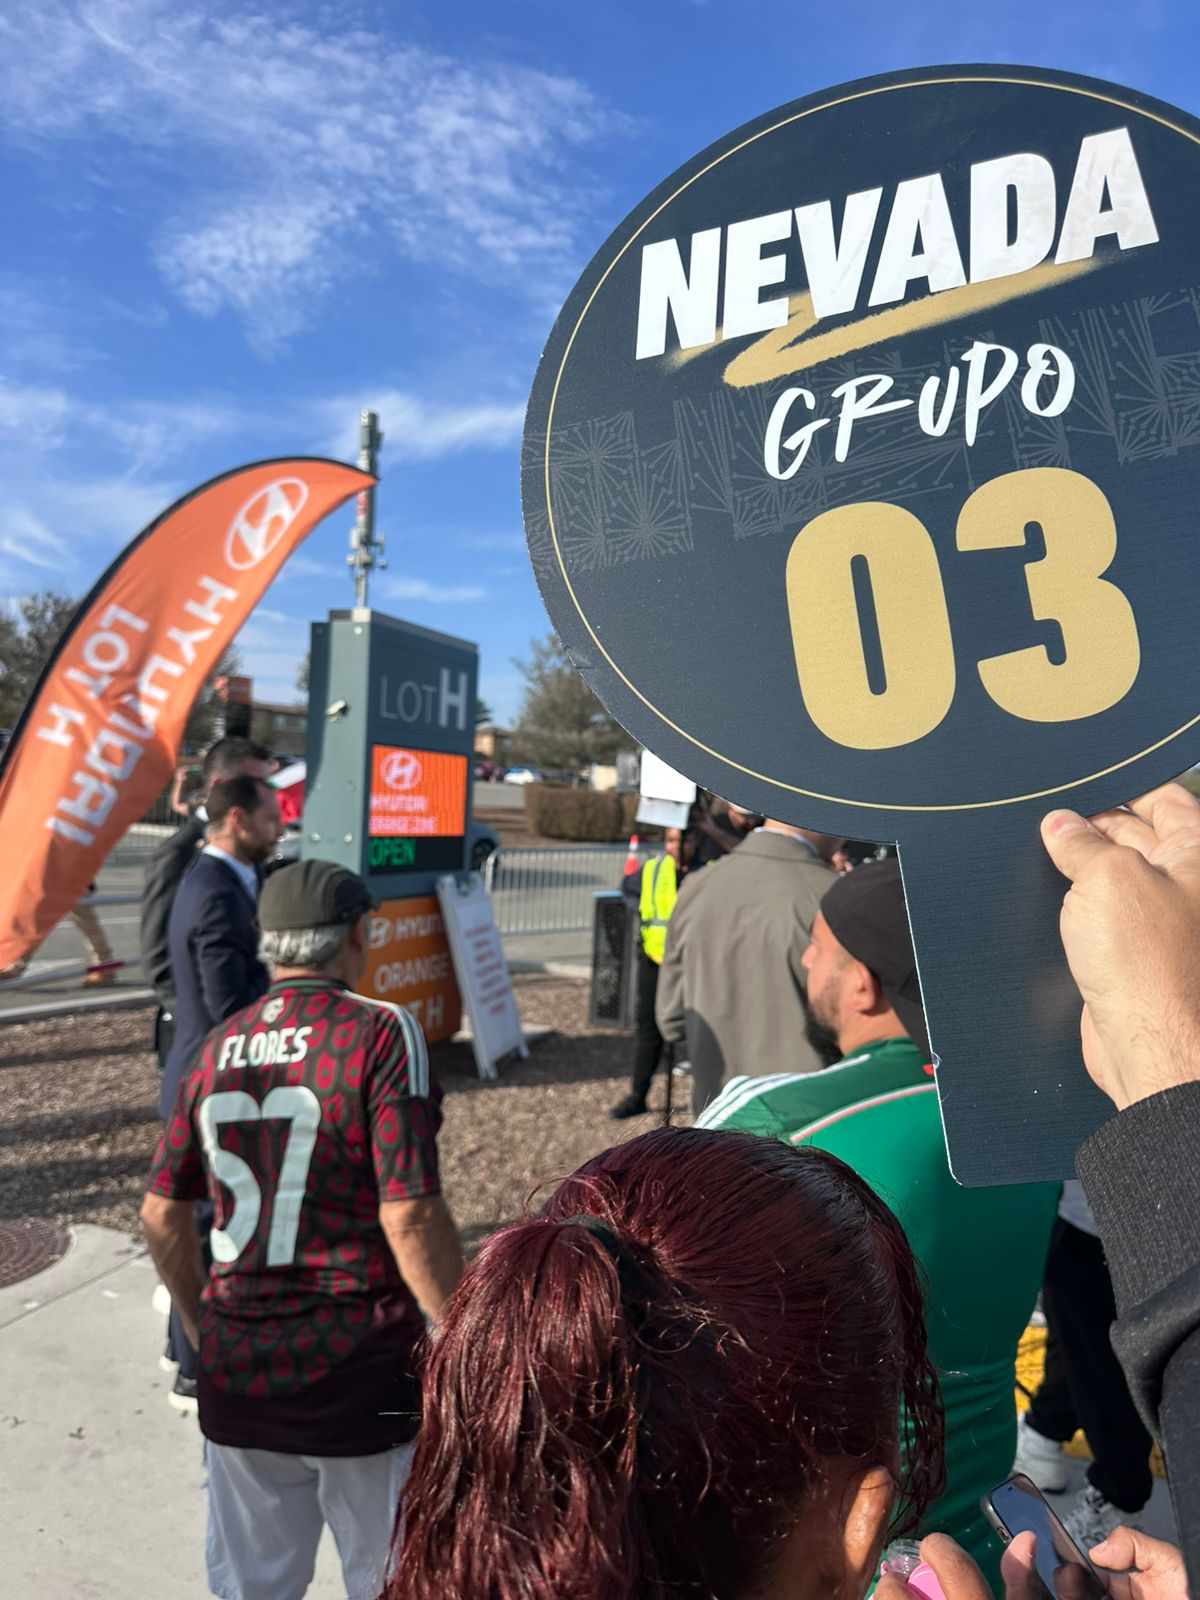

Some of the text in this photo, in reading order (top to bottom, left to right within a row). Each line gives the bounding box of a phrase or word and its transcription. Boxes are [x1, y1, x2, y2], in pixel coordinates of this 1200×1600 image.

[636, 127, 1160, 361] NEVADA
[763, 341, 1076, 481] GRUPO
[36, 602, 151, 748] LOT H
[785, 467, 1141, 750] 03
[368, 838, 416, 867] OPEN
[374, 953, 449, 995] ORANGE
[217, 1026, 313, 1072] FLORES
[200, 1086, 322, 1268] 57
